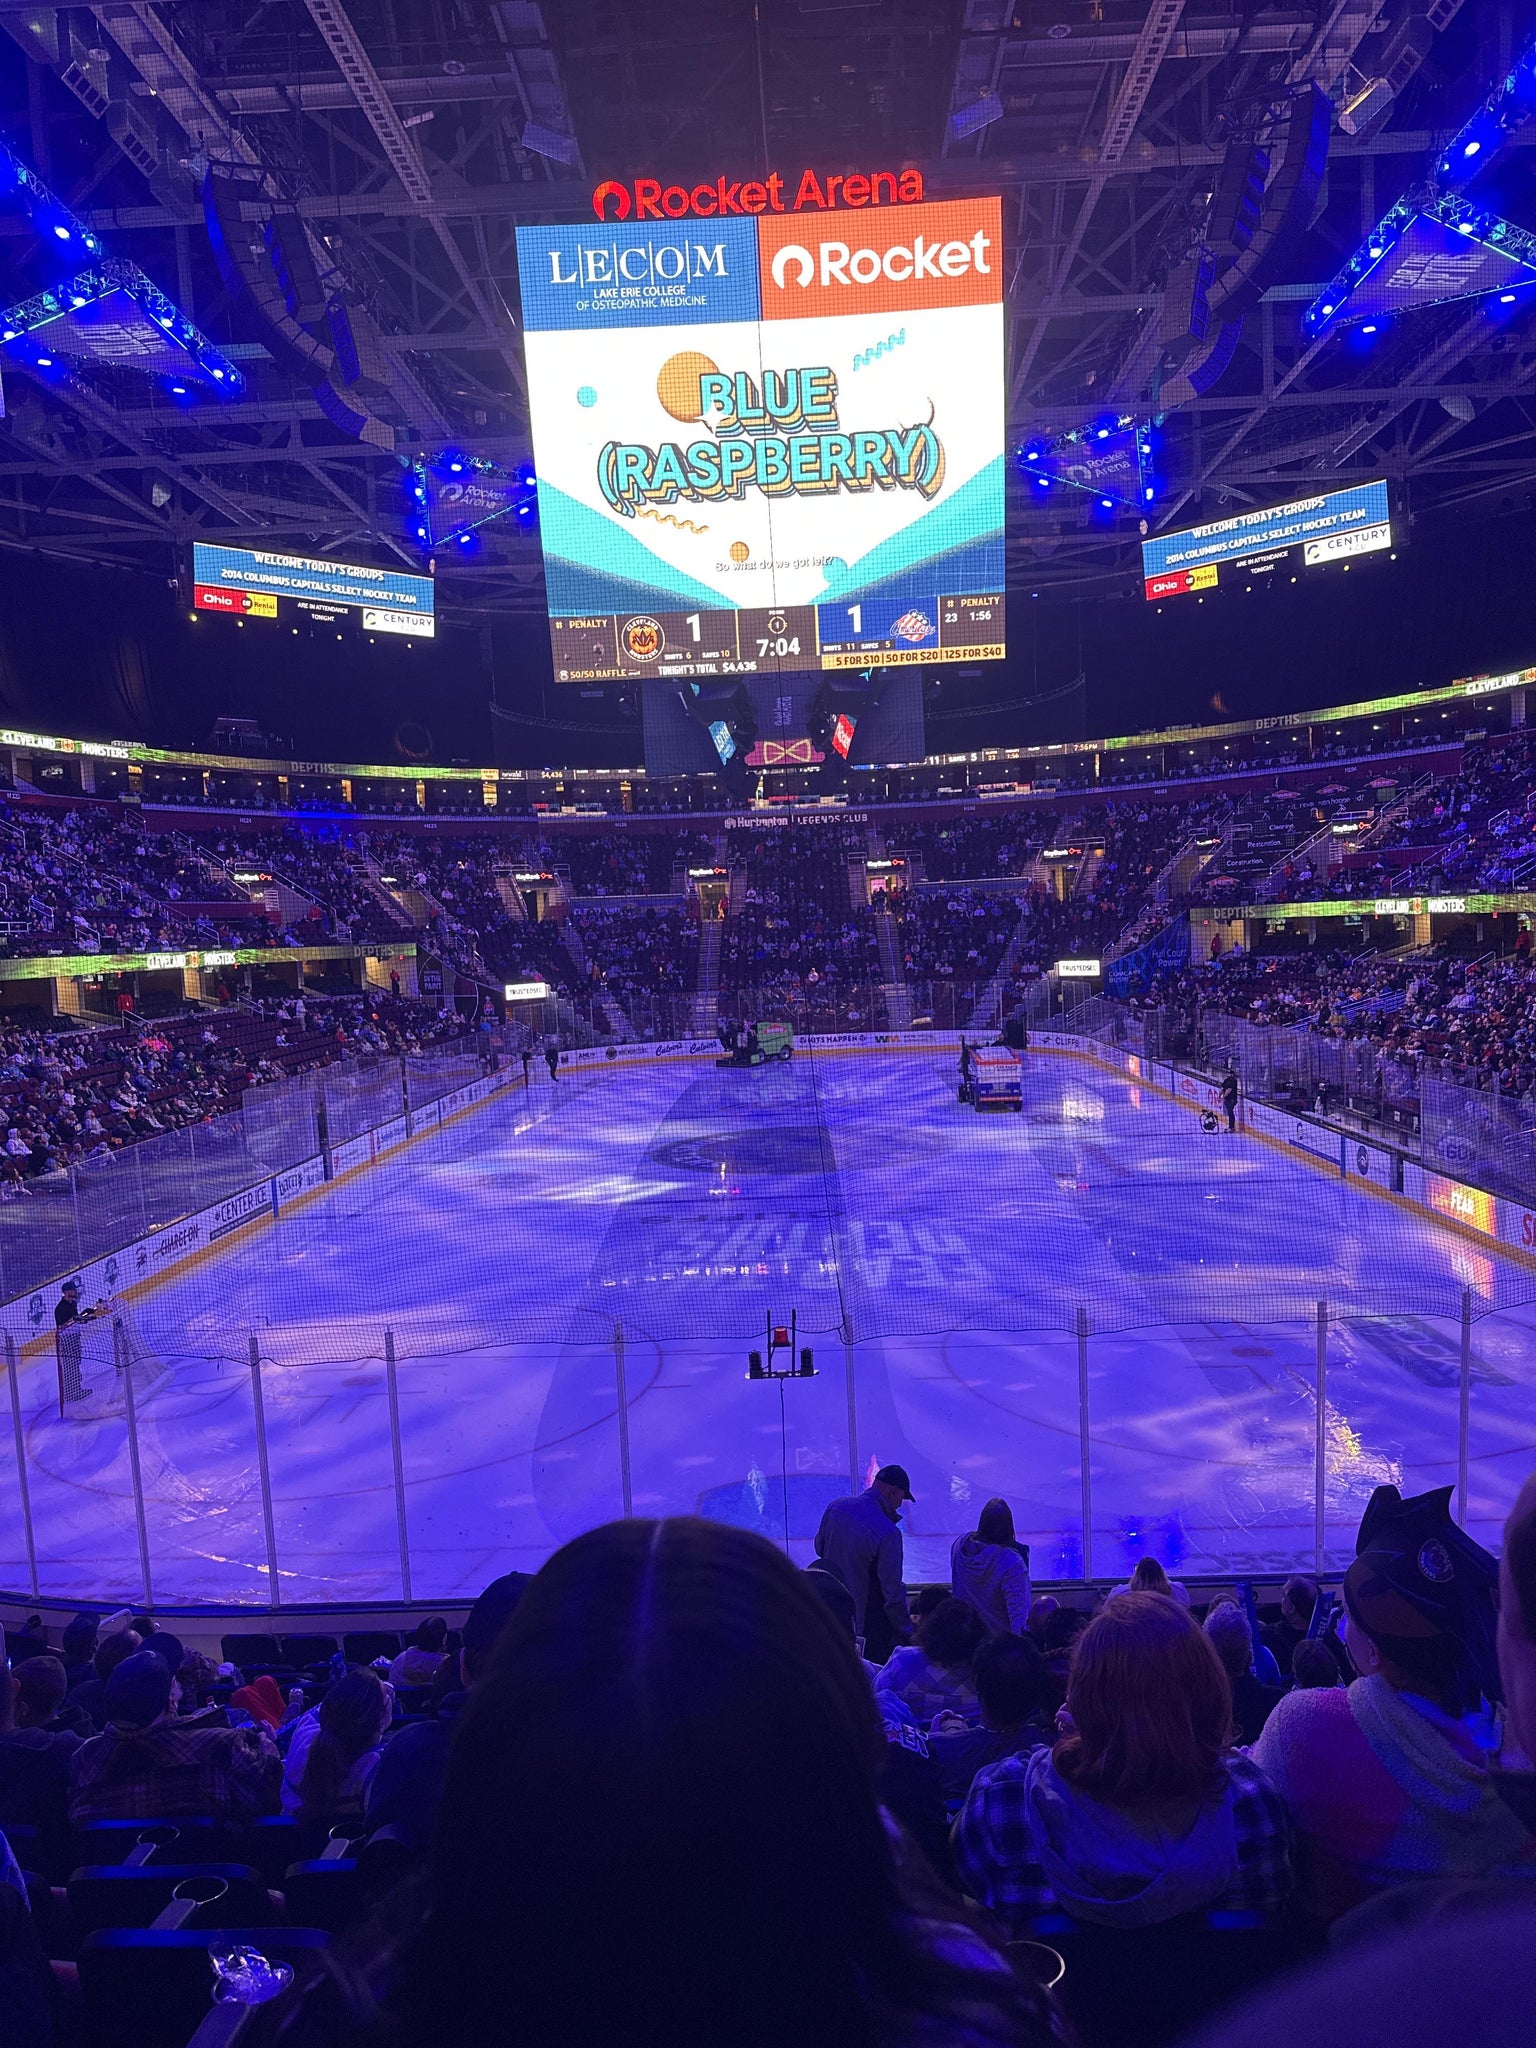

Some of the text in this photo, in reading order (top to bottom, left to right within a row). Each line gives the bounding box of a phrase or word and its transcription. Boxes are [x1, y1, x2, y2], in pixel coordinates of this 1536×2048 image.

[636, 169, 923, 219] Rocket Arena
[820, 228, 991, 287] Rocket
[594, 284, 686, 299] LAKE ERIE COLLEGE
[576, 296, 707, 311] OF OSTEOPATHIC MEDICINE
[699, 366, 838, 432] BLUE
[597, 424, 943, 508] (RASPBERRY)
[1086, 450, 1130, 469] Rocket
[1095, 460, 1131, 478] Arena
[465, 485, 507, 500] Rocket
[460, 495, 496, 509] Arena
[1192, 498, 1326, 539] WELCOME TODAY'S GROUPS
[1165, 508, 1366, 565] 2014 COLUMBUS CAPITALS SELECT HOCKEY TEAM
[1328, 528, 1387, 550] CENTURY
[1254, 550, 1288, 564] ATTENDANCE
[254, 552, 384, 581] WELCOME TODAY'S GROUPS
[716, 562, 729, 572] So
[734, 561, 757, 571] what
[760, 560, 772, 570] do
[776, 560, 790, 568] we
[793, 558, 810, 570] got
[221, 568, 416, 604] 2014 COLUMBUS CAPITALS SELECT HOCKEY TEAM
[1153, 582, 1178, 592] Ohio
[204, 594, 232, 606] Ohio
[961, 596, 1000, 608] PENALTY
[316, 604, 348, 614] ATTENDANCE
[384, 613, 432, 627] CENTURY
[569, 619, 608, 628] PENALTY
[848, 604, 862, 633] 1
[945, 611, 992, 623] 23 1:56
[686, 613, 700, 642] 1
[686, 651, 692, 659] 6
[720, 650, 730, 658] 10
[756, 638, 800, 658] 7:04
[836, 647, 1002, 666] 5 FOR $10 50 FOR $20 125 FOR $40
[570, 670, 594, 678] 50/50
[596, 669, 626, 678] RAFFLE
[658, 661, 758, 676] TONIGHT'S TOTAL $4,436
[1466, 674, 1518, 695] CLEVELAND
[1256, 714, 1300, 730] DEPTHS
[2, 730, 56, 750] CLEVELAND
[81, 743, 128, 758] MONSTERS
[929, 756, 939, 765] 11
[970, 753, 977, 761] 5
[291, 761, 334, 774] DEPTHS
[798, 815, 840, 824] LEGENDS
[843, 814, 868, 822] CLUB
[1214, 906, 1256, 919] DEPTHS
[1375, 898, 1466, 914] CLEVELAND MONSTERS
[354, 945, 394, 956] DEPTHS
[147, 952, 236, 969] CLEVELAND MONSTERS
[221, 1192, 253, 1222] CENTER
[254, 1186, 267, 1206] ICE
